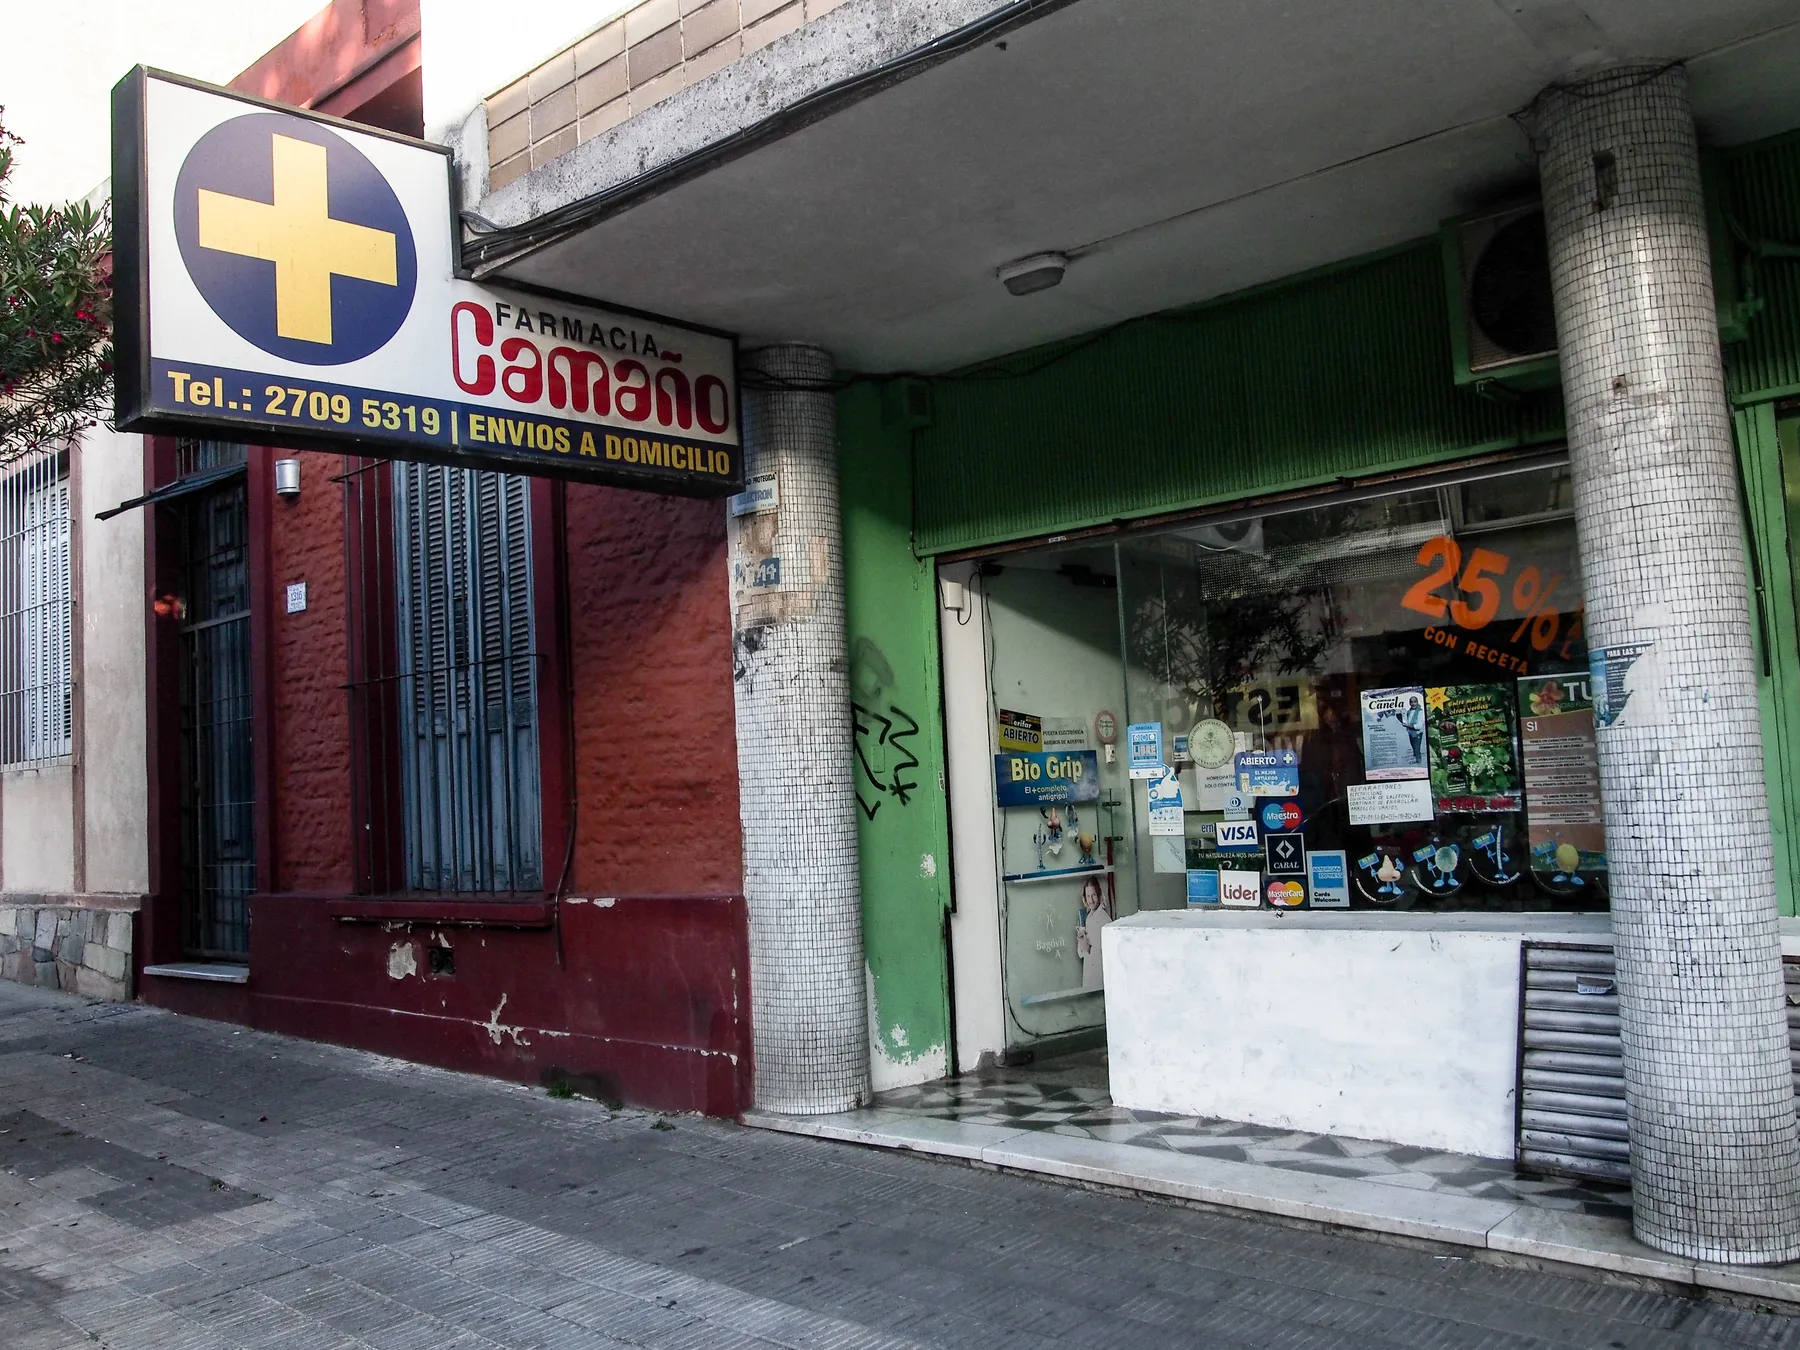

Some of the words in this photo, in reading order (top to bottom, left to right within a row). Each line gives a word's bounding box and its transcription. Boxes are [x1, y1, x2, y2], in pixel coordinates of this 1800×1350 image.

[494, 301, 660, 359] FARMACIA
[450, 300, 730, 436] Camaño
[167, 370, 254, 414] Tel.:
[263, 384, 350, 426] 2709
[361, 398, 442, 437] 5319
[468, 414, 571, 456] ENVIOS
[579, 435, 597, 457] A
[604, 435, 731, 477] DOMICILIO
[1400, 535, 1566, 651] 25%
[1423, 626, 1459, 649] CON
[1466, 641, 1530, 676] RECETA
[1368, 696, 1404, 710] Canela
[1526, 721, 1538, 732] SI
[1003, 727, 1040, 744] ABIERTO
[1240, 756, 1277, 766] ABIERTO
[1010, 758, 1041, 782] Bio
[1046, 756, 1083, 783] Grip
[1350, 784, 1402, 792] REPARACIONES
[1038, 793, 1068, 801] antigripal
[1266, 811, 1298, 821] Maestro
[1220, 826, 1256, 841] VISA
[1274, 861, 1300, 869] CABAL
[1268, 889, 1304, 898] MasterCard
